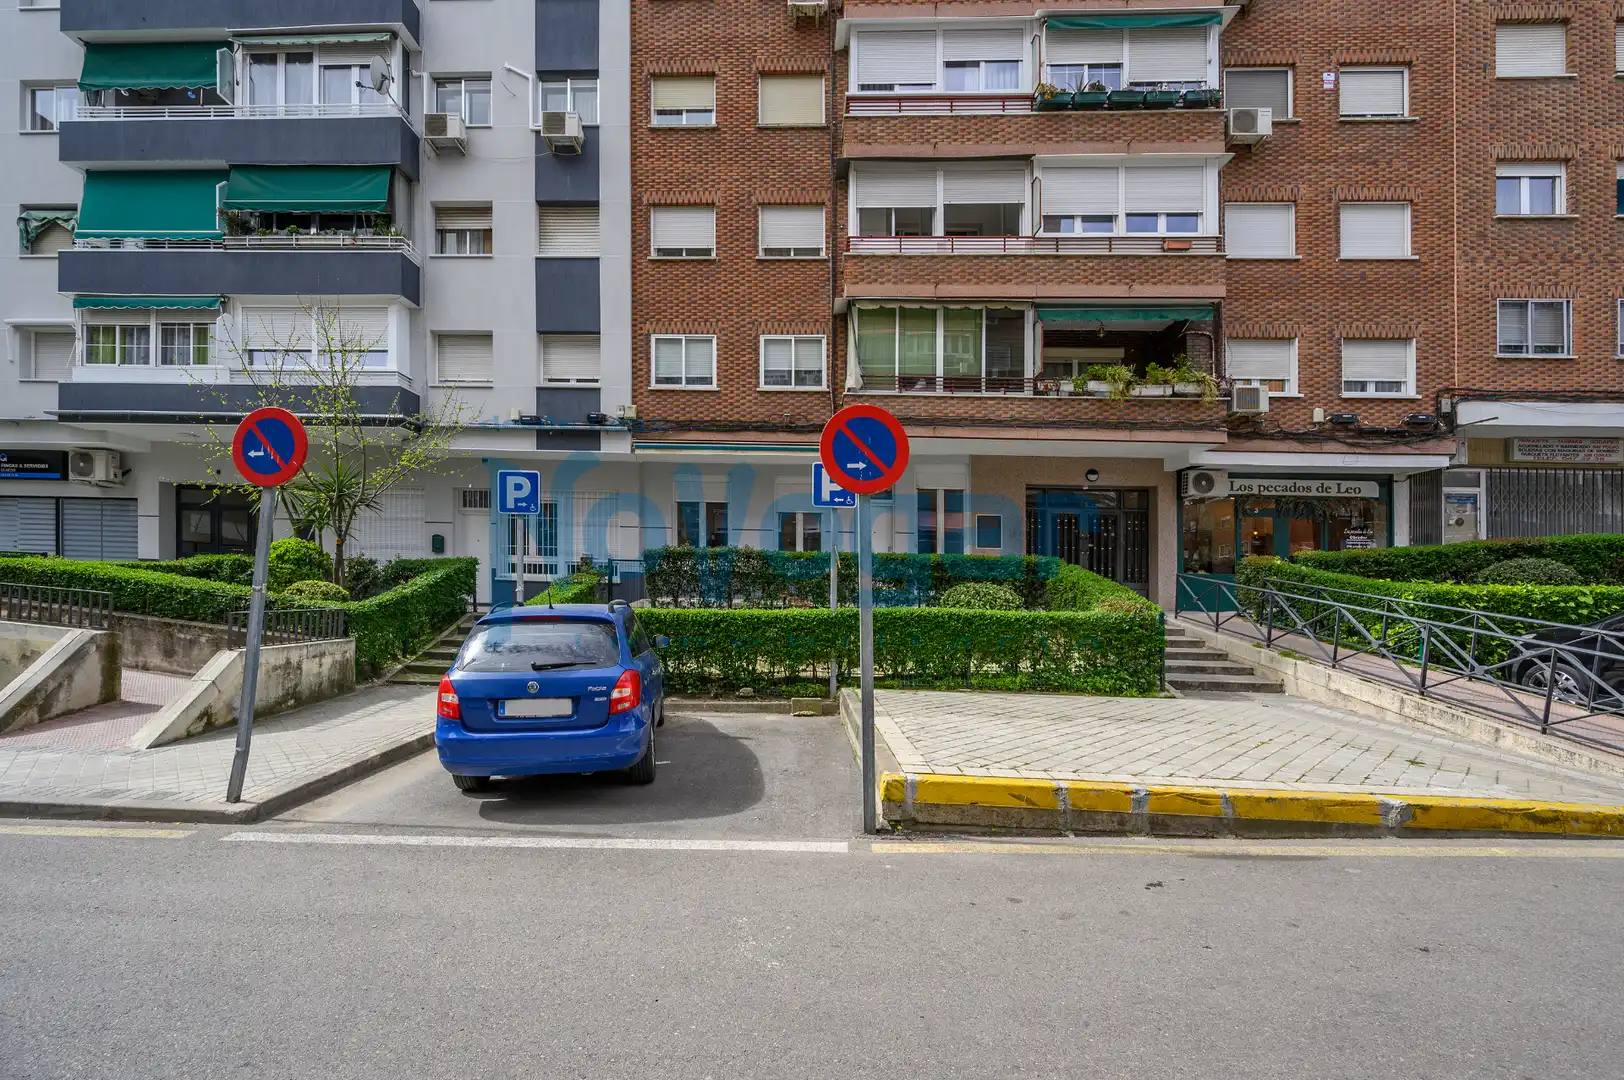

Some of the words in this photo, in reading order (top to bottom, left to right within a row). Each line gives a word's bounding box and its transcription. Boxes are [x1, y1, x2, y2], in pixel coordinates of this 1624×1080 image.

[506, 475, 531, 508] P
[1228, 480, 1253, 492] Los
[1257, 481, 1312, 495] pecados
[1316, 482, 1332, 494] de
[1336, 483, 1361, 495] Leo
